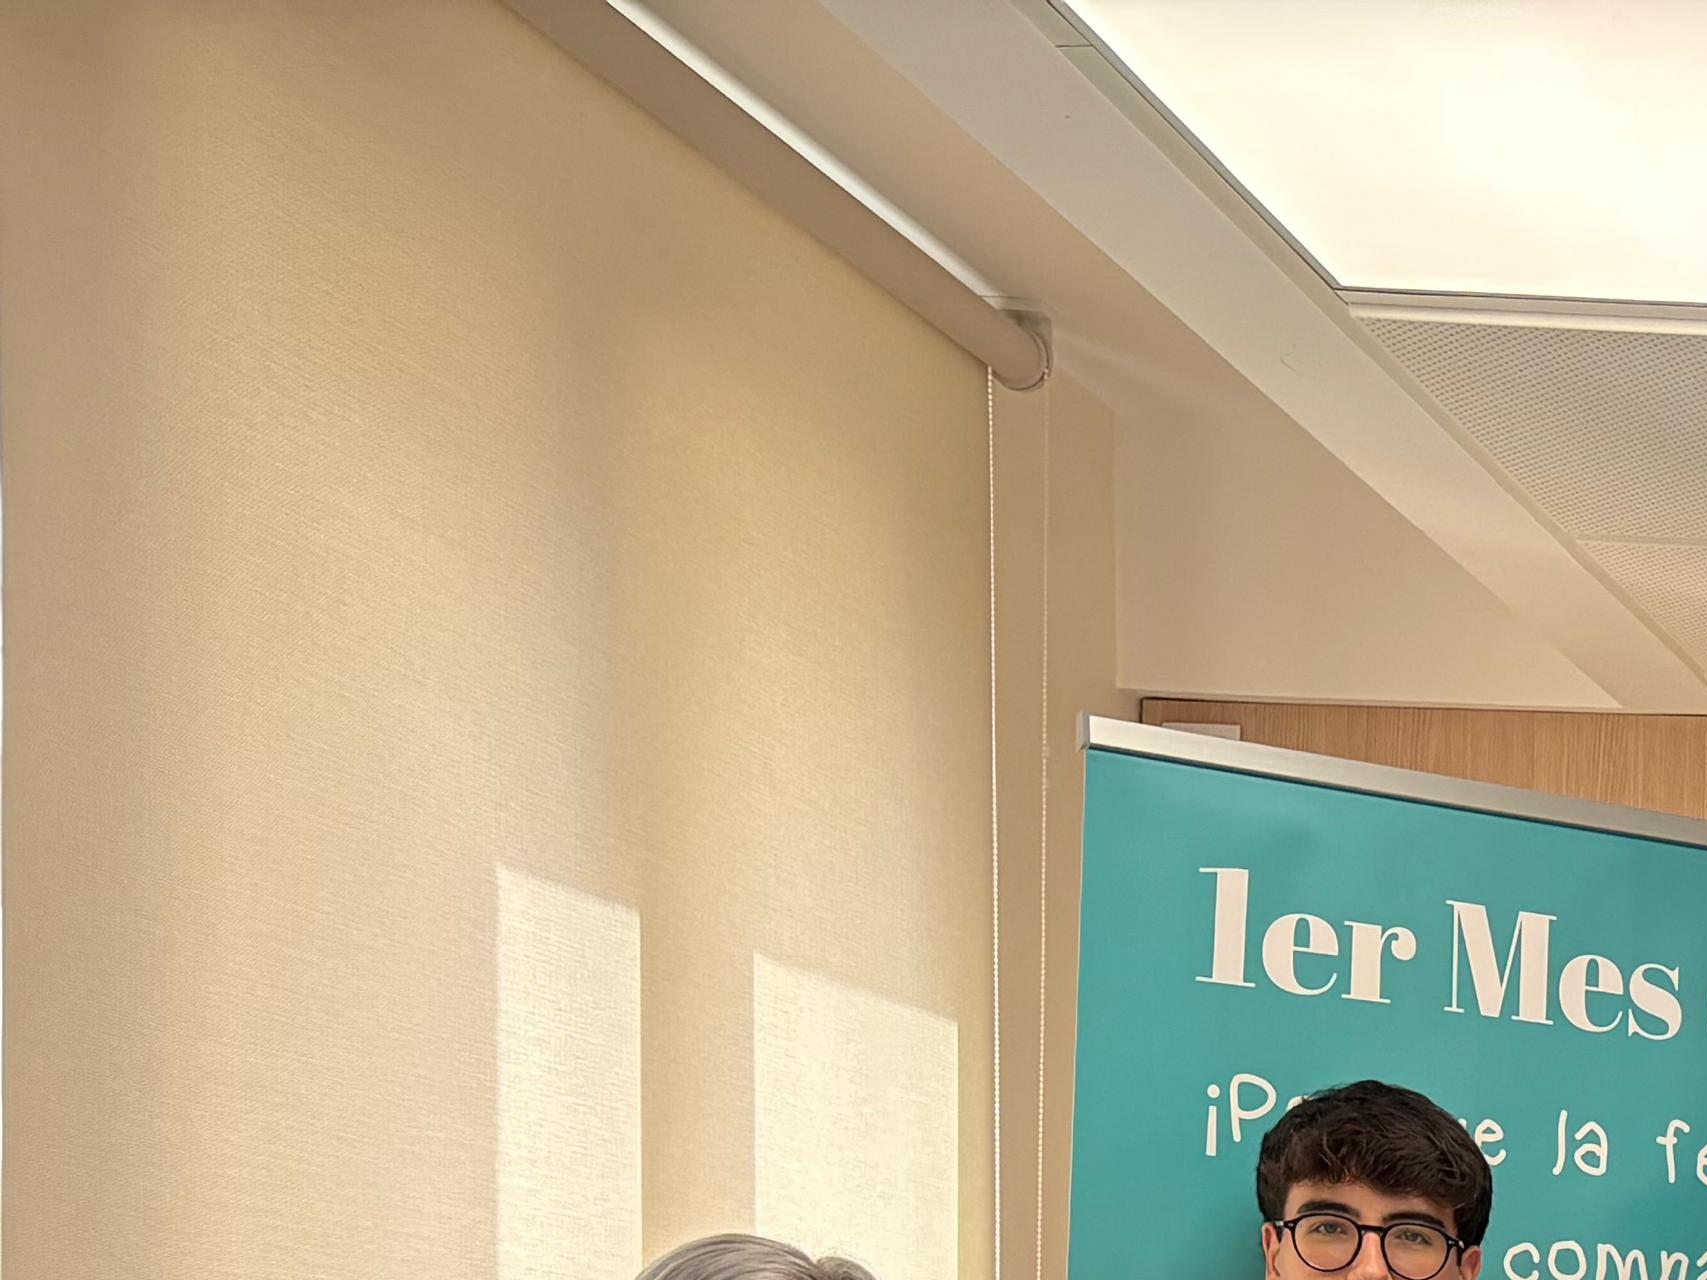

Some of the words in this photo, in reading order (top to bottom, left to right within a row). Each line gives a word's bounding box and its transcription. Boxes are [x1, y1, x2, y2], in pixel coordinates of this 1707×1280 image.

[1195, 867, 1417, 1004] 1er
[1444, 899, 1682, 1041] Mes
[1551, 1108, 1610, 1177] la
